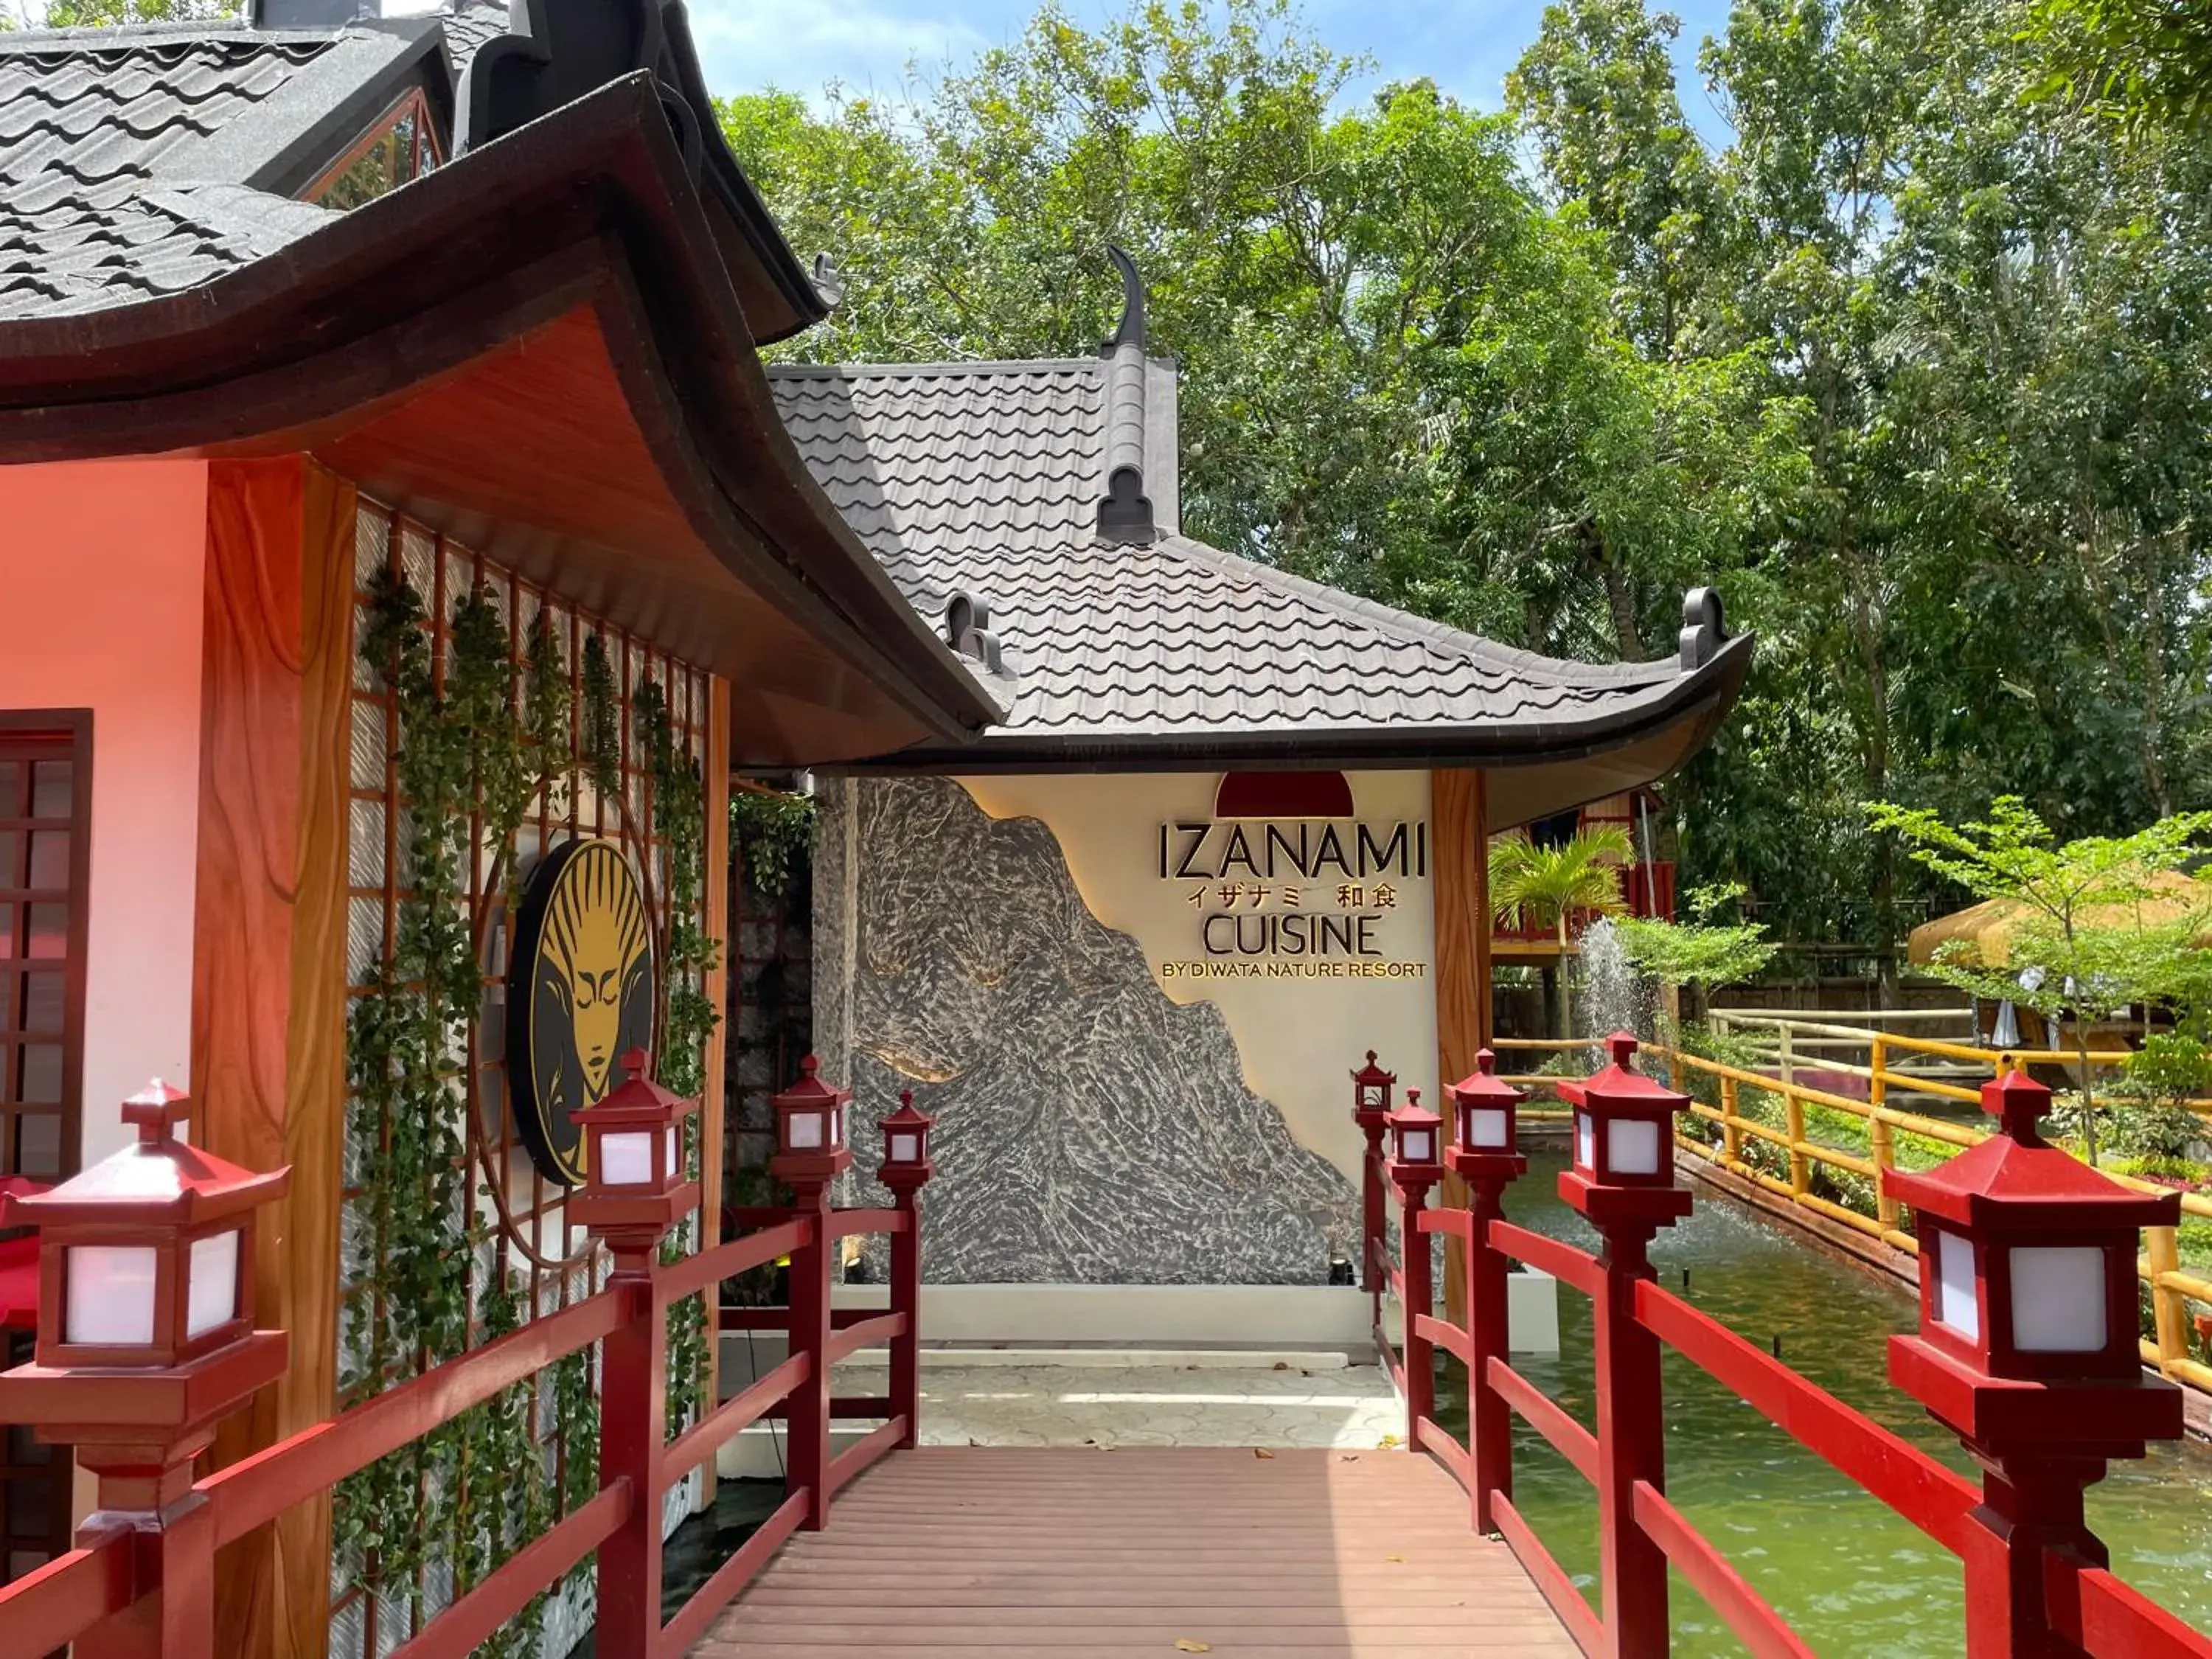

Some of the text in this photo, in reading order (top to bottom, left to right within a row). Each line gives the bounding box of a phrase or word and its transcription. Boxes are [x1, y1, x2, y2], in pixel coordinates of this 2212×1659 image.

[1160, 821, 1425, 879] IZANAMI
[1188, 882, 1397, 908] イザナミ 和食
[1203, 914, 1383, 956] CUISINE
[1162, 964, 1427, 978] BY DIWATA NATURE RESORT
